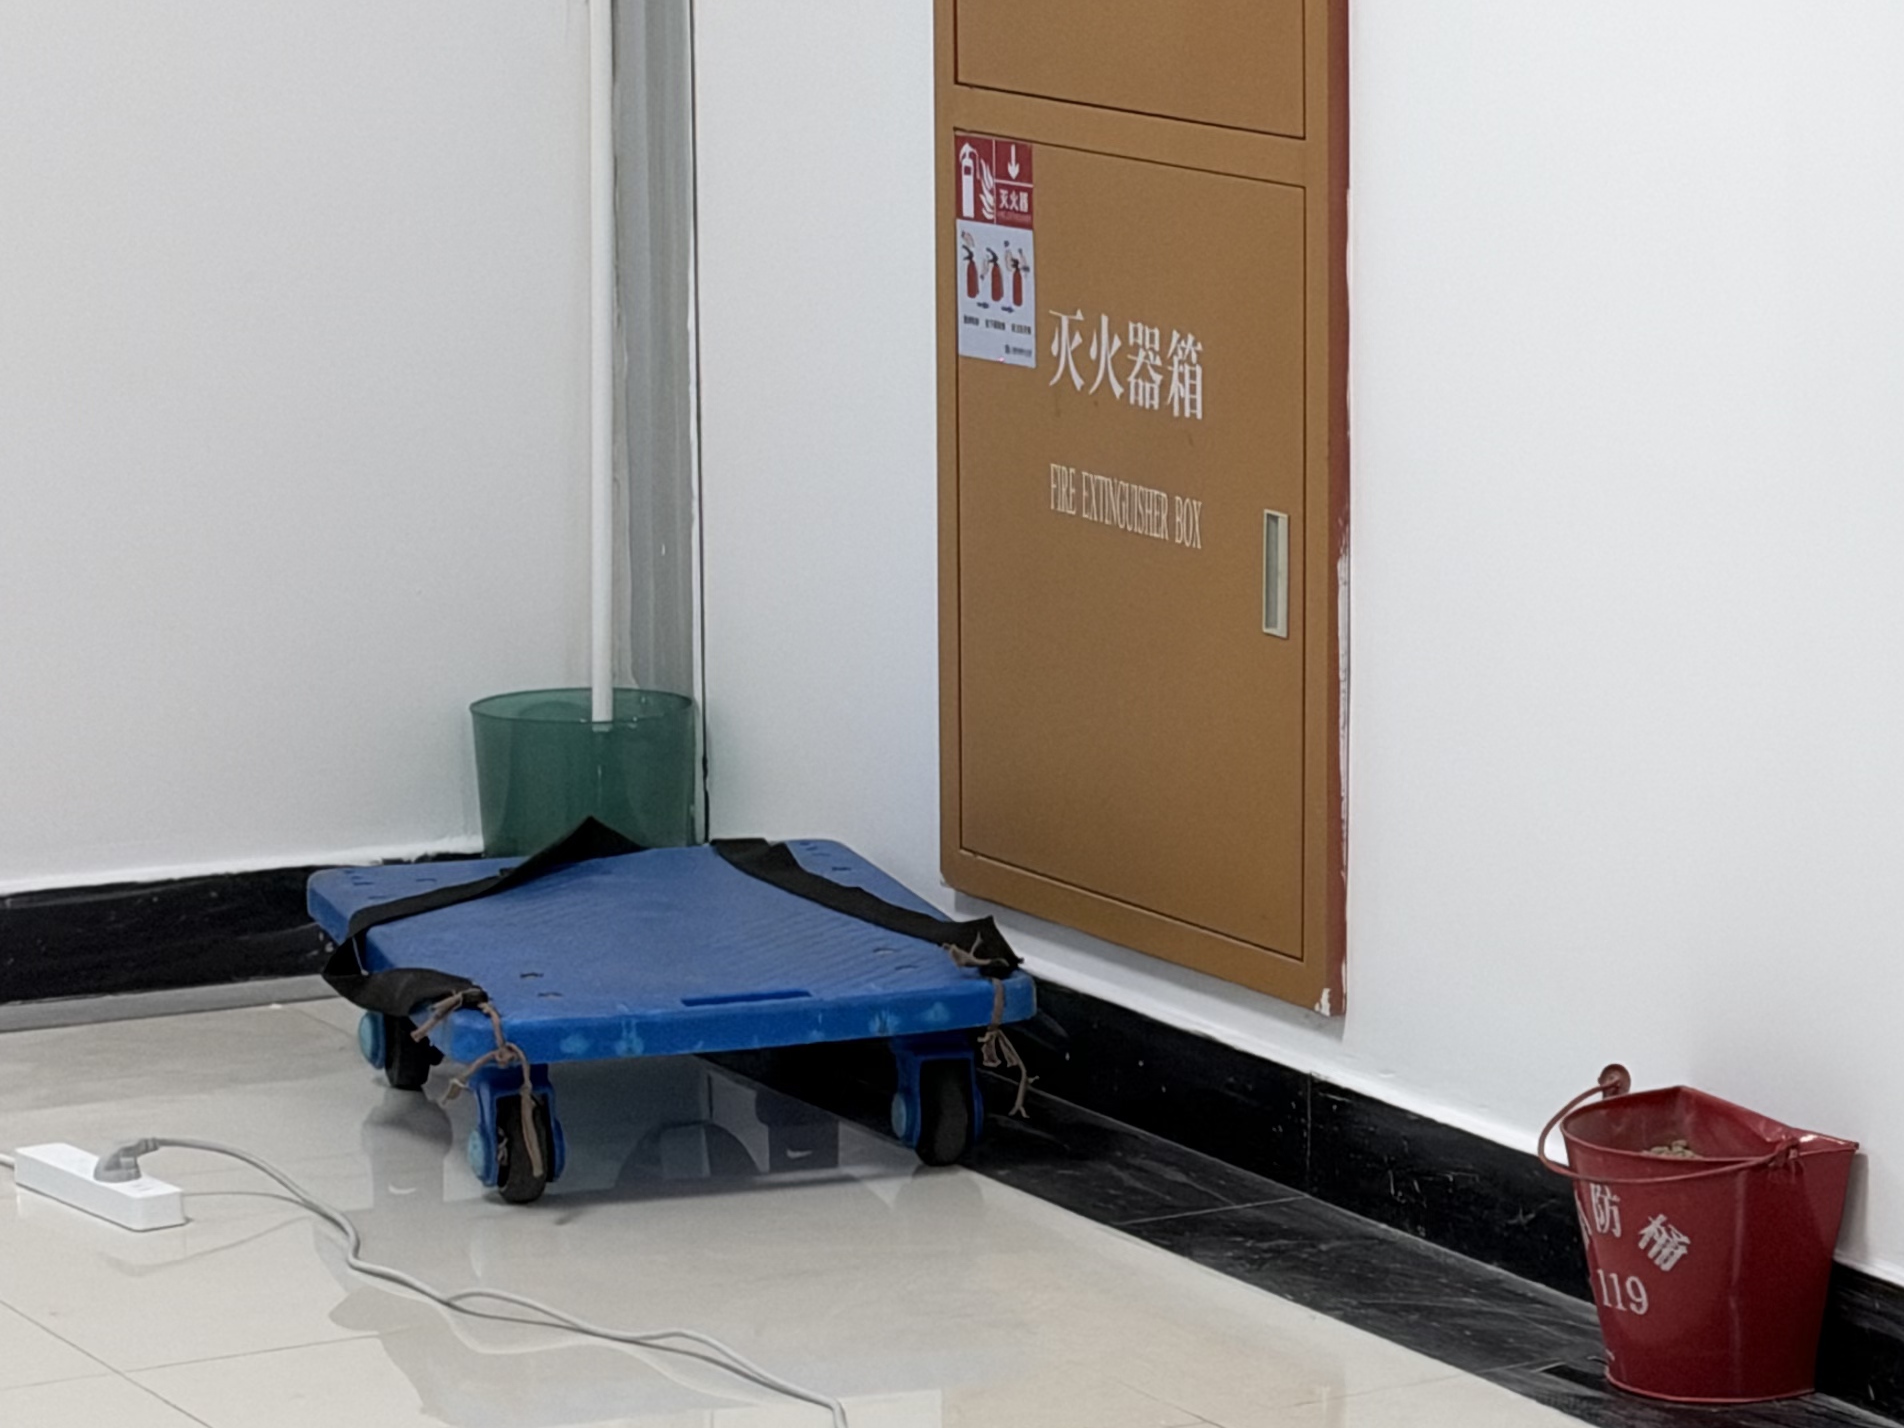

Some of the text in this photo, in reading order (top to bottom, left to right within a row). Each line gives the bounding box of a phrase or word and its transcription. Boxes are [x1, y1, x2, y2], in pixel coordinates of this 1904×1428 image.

[1049, 308, 1203, 420] 灭火器箱
[1050, 463, 1203, 549] FIRE EXTINGUISHER BOX
[1597, 1269, 1648, 1315] 119
